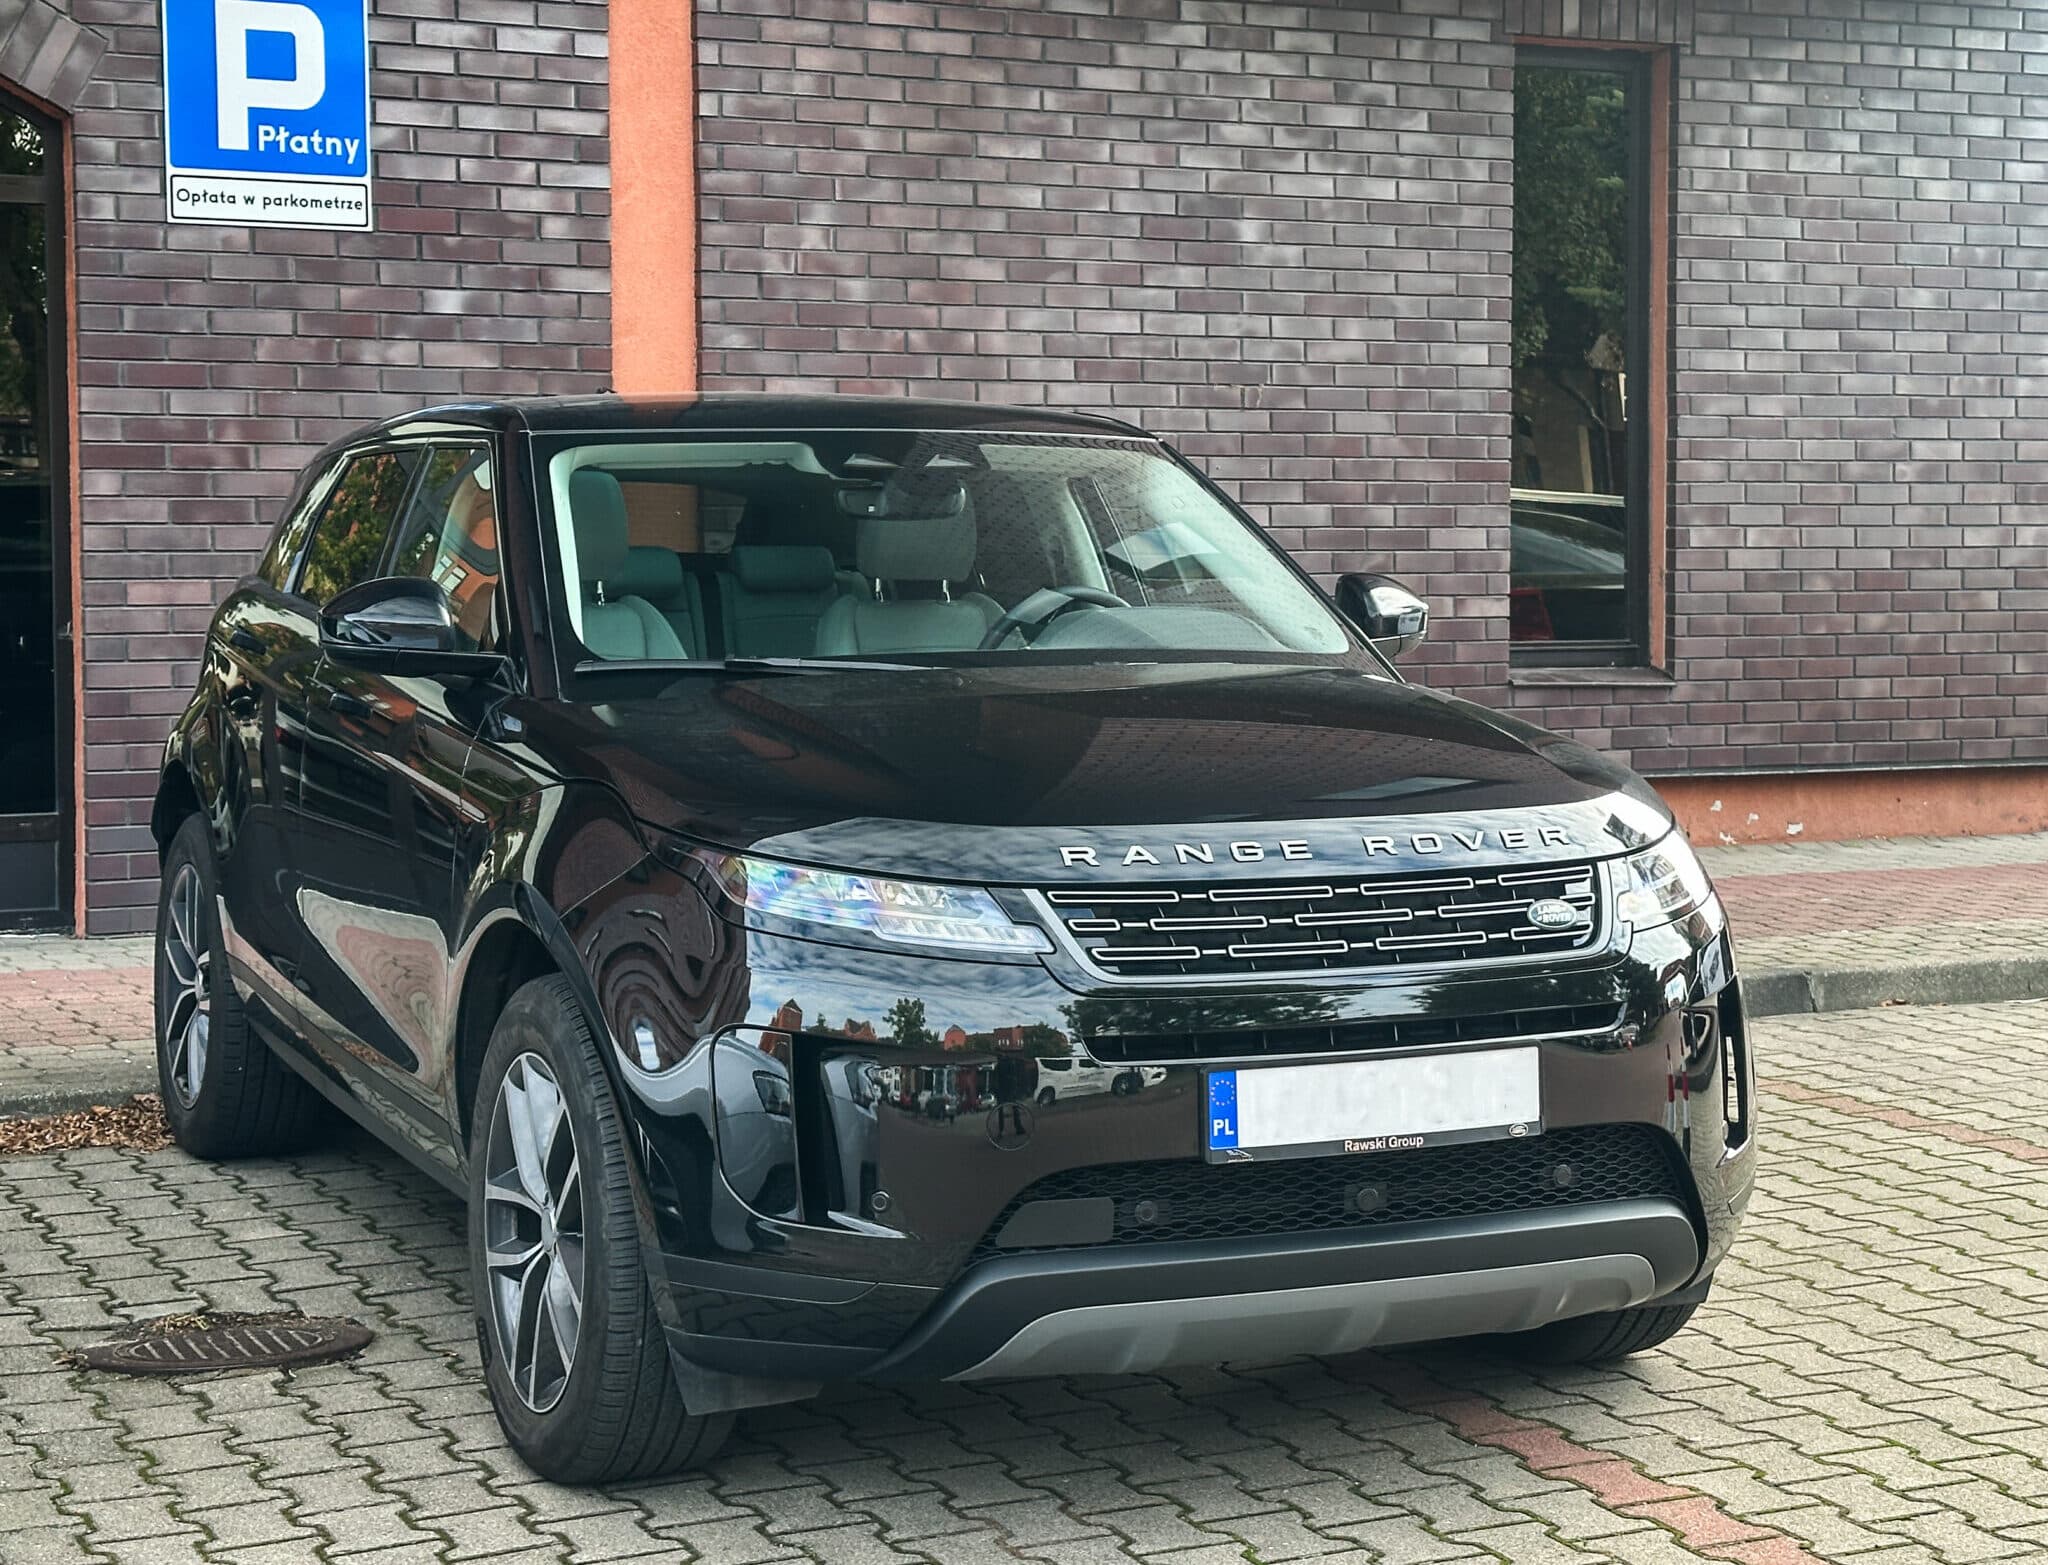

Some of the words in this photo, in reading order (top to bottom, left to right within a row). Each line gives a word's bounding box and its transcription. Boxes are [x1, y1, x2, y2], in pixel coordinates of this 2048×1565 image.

[215, 0, 326, 150] P
[258, 125, 360, 164] Płatny
[176, 188, 236, 206] Opłata
[243, 194, 255, 205] w
[263, 194, 363, 210] parkometrze
[1059, 839, 1313, 867] RANGE
[1362, 825, 1570, 857] ROVER
[1213, 1118, 1235, 1137] PL
[1344, 1137, 1386, 1152] Rawski
[1388, 1136, 1424, 1148] Group
